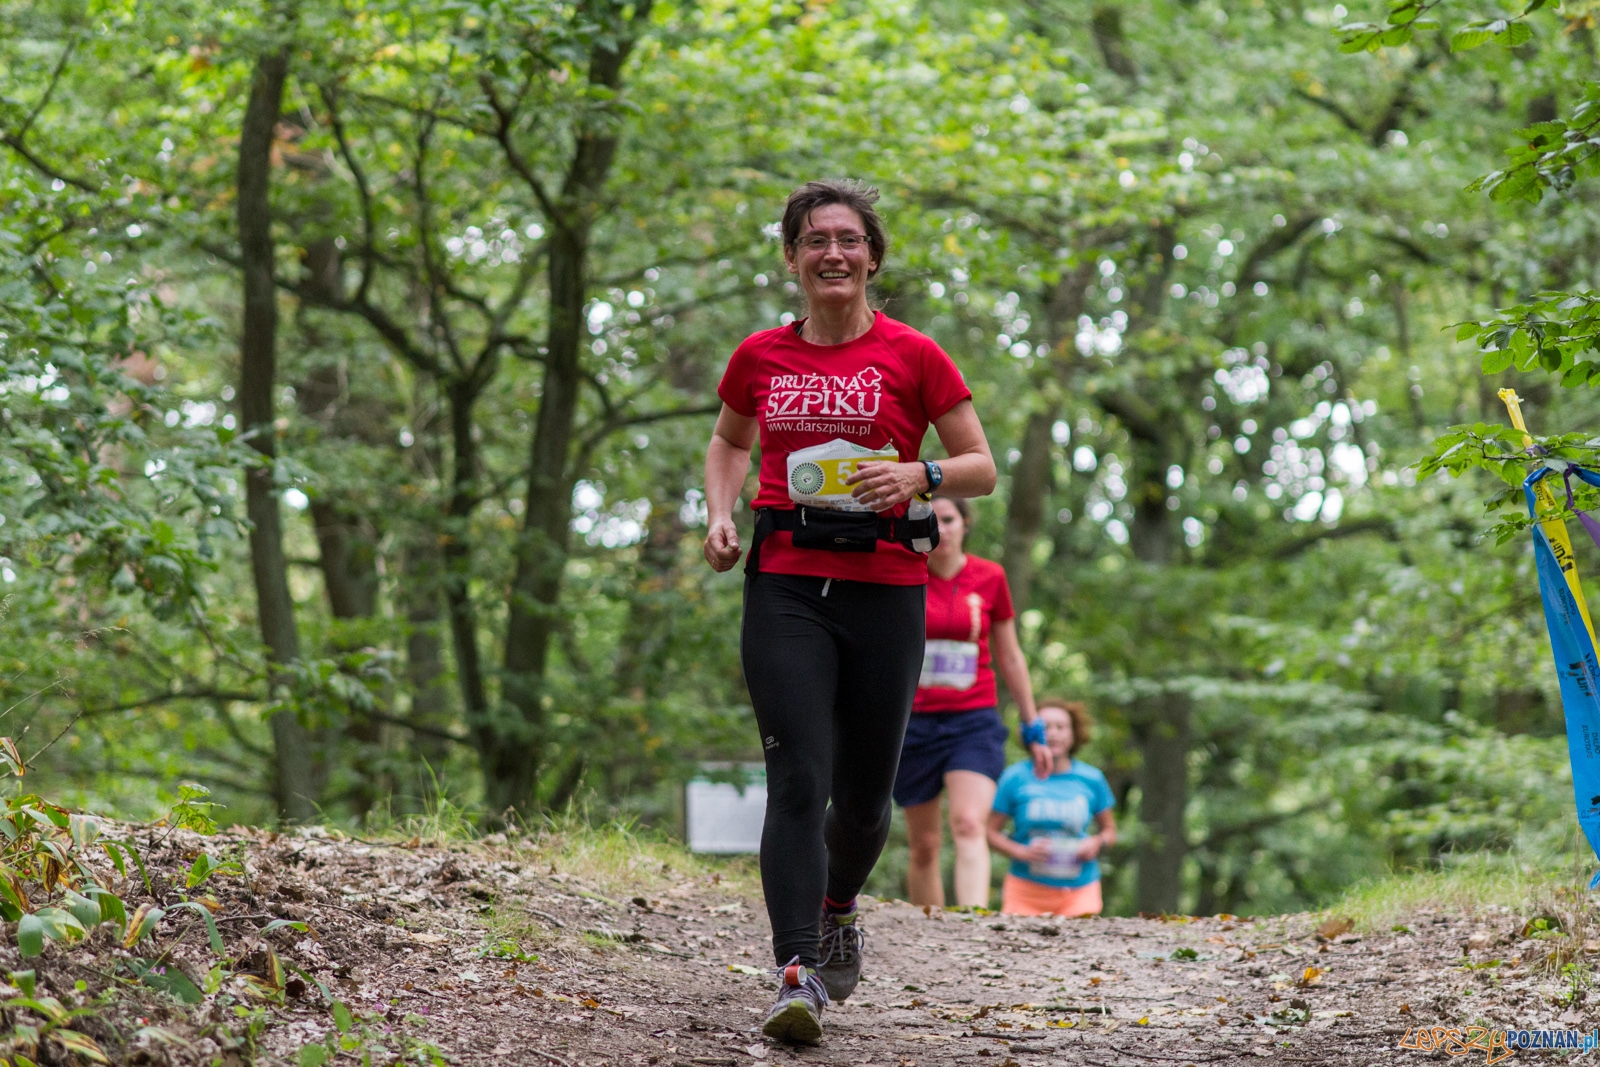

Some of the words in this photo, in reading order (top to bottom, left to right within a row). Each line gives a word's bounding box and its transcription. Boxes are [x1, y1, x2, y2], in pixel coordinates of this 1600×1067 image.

[770, 372, 861, 391] DRUŻYNA
[765, 389, 881, 418] SZPIKU
[767, 420, 871, 437] www.darszpiku.pl
